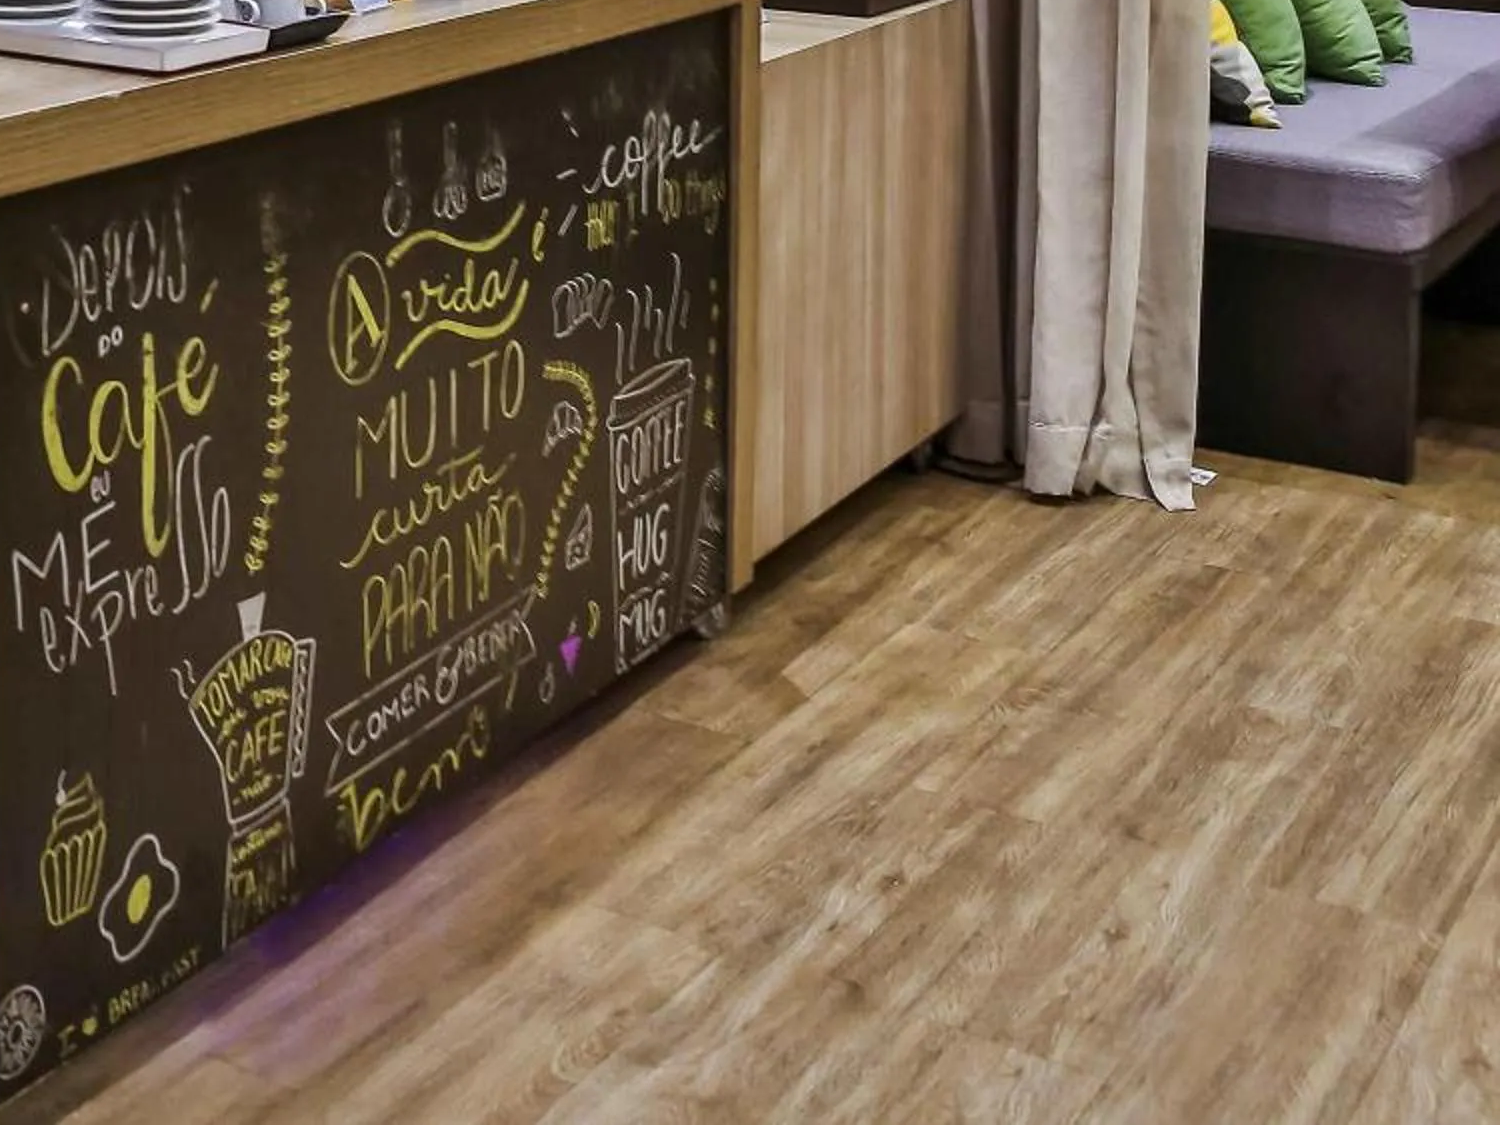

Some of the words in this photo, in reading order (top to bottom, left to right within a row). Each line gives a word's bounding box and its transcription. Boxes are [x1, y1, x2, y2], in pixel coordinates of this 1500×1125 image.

[343, 274, 386, 374] A
[401, 258, 519, 323] vida
[355, 339, 525, 499] MUITO
[11, 500, 120, 632] ME
[339, 444, 518, 569] curta
[617, 502, 671, 592] HUG
[361, 535, 454, 679] PARA
[618, 589, 667, 657] MUG
[346, 674, 431, 756] COMER
